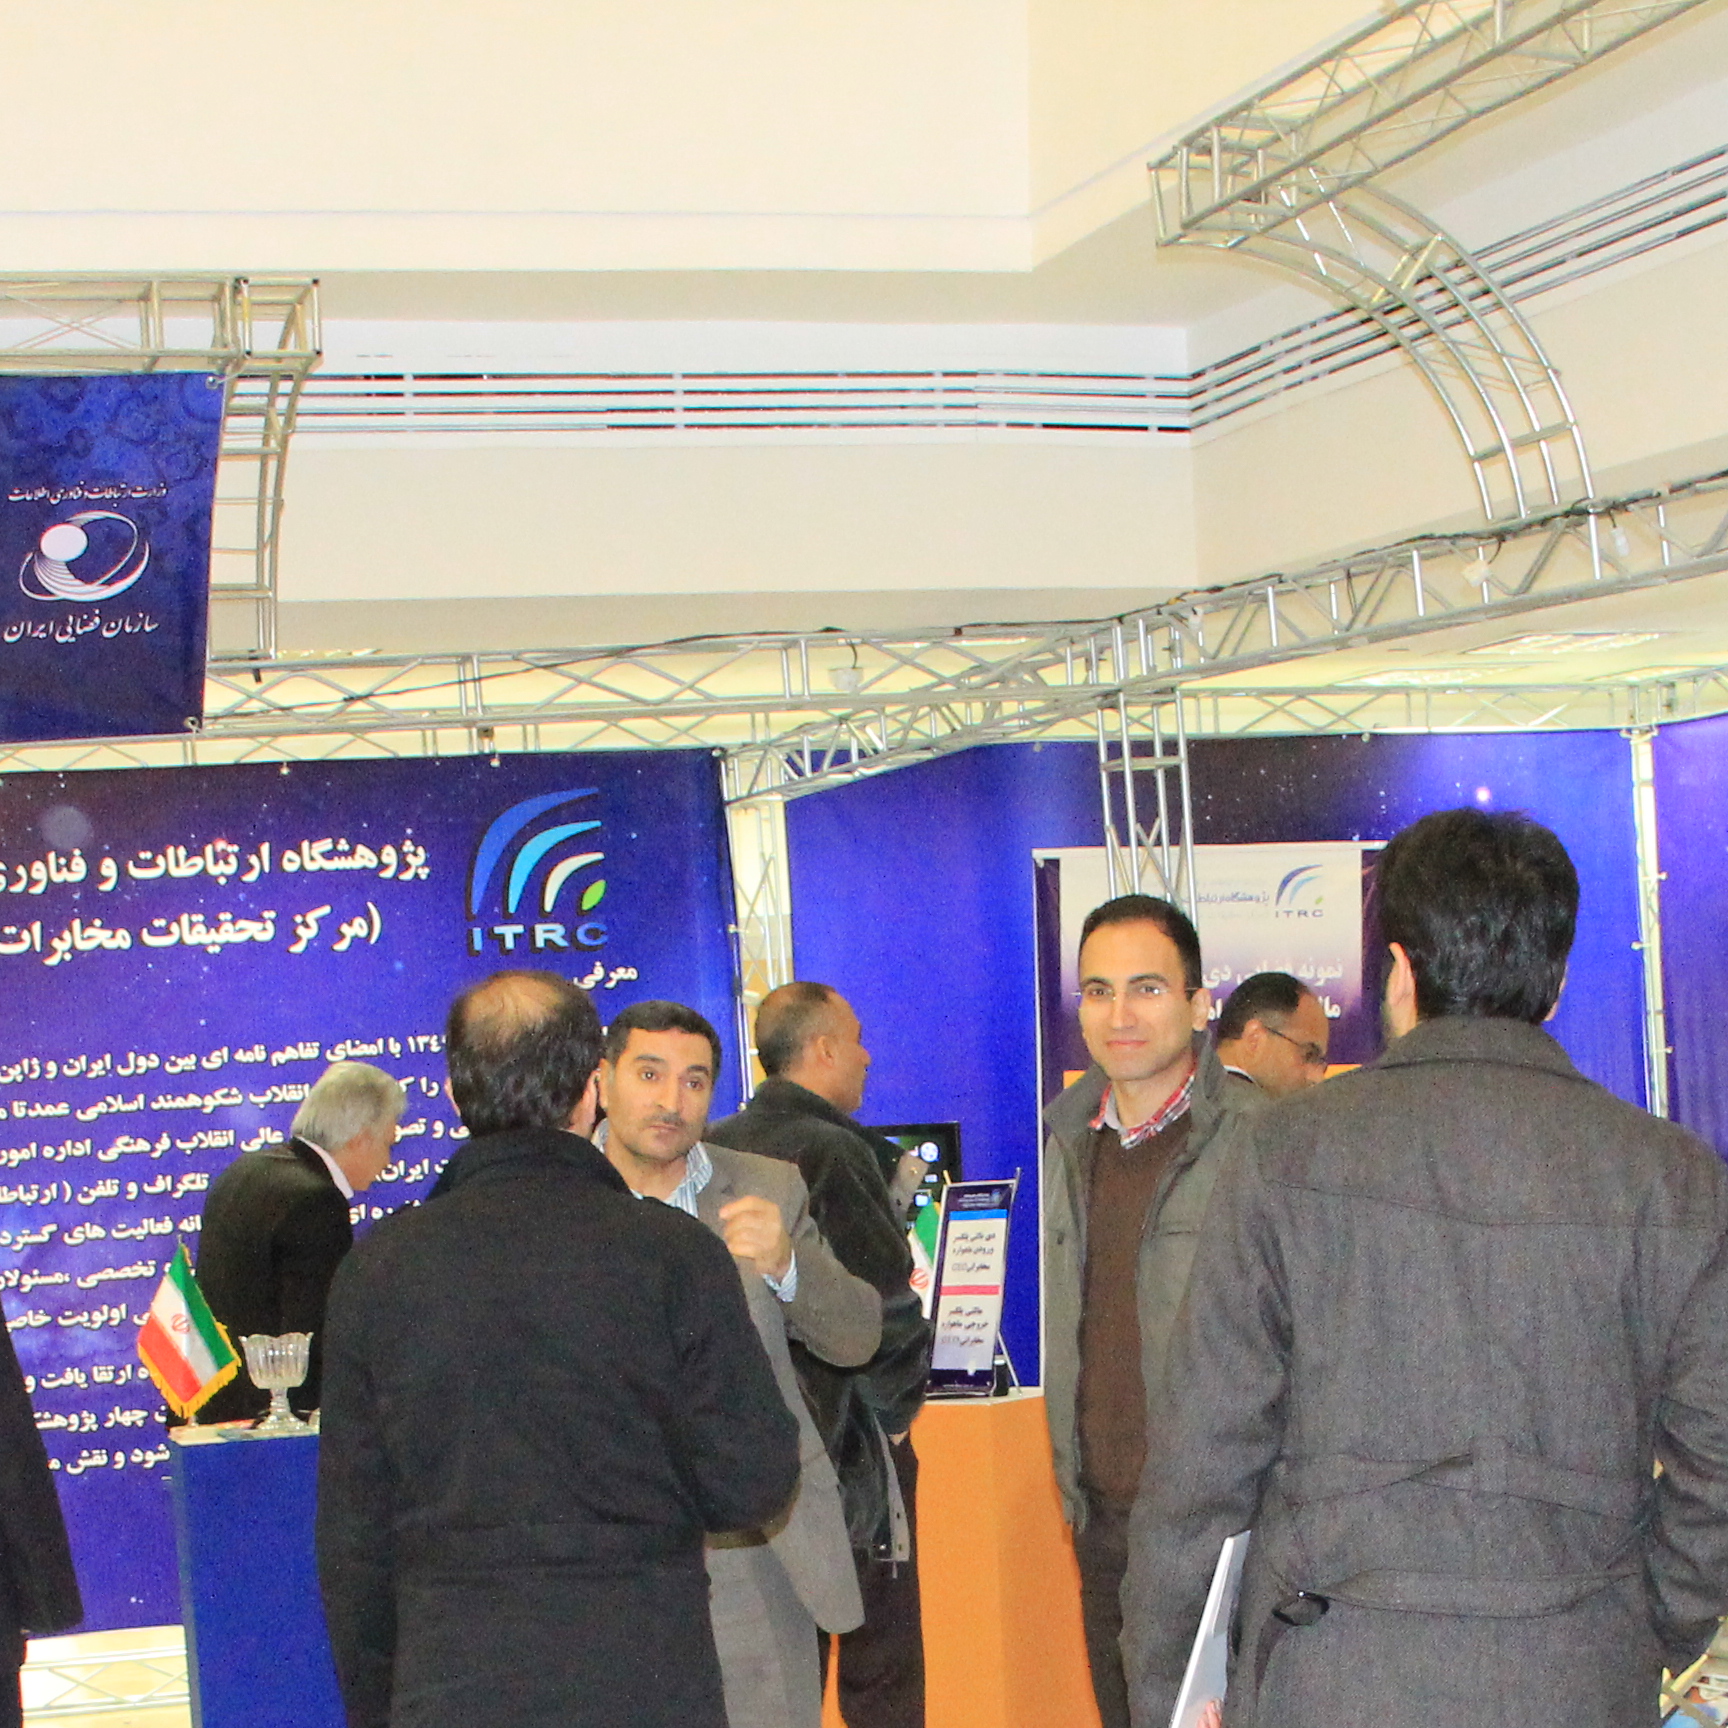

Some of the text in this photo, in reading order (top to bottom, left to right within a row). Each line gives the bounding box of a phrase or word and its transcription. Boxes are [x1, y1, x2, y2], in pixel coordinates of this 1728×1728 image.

[3, 608, 159, 643] سازمان فضایی ایران
[127, 840, 270, 886] ارتباطات
[282, 837, 431, 881] پژوهشگاه
[97, 855, 120, 893] و
[1275, 908, 1324, 918] ITRC
[140, 909, 278, 954] تحقیقات
[286, 901, 383, 954] (مرکز
[469, 921, 610, 953] ITRC
[572, 960, 640, 990] معرفی
[1298, 957, 1344, 987] نمونه
[200, 1046, 229, 1071] ای
[233, 1043, 267, 1063] نامه
[270, 1041, 321, 1067] تفاهم
[325, 1037, 385, 1062] امضای
[387, 1037, 403, 1059] با
[44, 1060, 58, 1080] و
[62, 1053, 112, 1079] ایران
[115, 1050, 161, 1076] دول
[164, 1051, 197, 1074] بین
[150, 1085, 243, 1114] شکوهمند
[248, 1082, 311, 1109] انقلاب
[419, 1076, 441, 1097] را
[11, 1100, 71, 1119] عمدتا
[75, 1093, 145, 1122] اسلامی
[175, 1129, 235, 1155] انقلاب
[239, 1126, 284, 1152] عالی
[432, 1119, 445, 1139] و
[41, 1138, 92, 1162] اداره
[96, 1131, 172, 1162] فرهنگی
[76, 1178, 121, 1205] تلفن
[125, 1180, 139, 1200] و
[142, 1172, 210, 1199] تلگراف
[62, 1221, 107, 1246] های
[110, 1214, 174, 1241] فعالیت
[76, 1259, 157, 1289] تخصصی
[56, 1302, 128, 1329] اولویت
[24, 1362, 133, 1394] ارتقا یافت و
[103, 1405, 149, 1429] چهار
[65, 1448, 109, 1475] نقش
[113, 1450, 126, 1470] و
